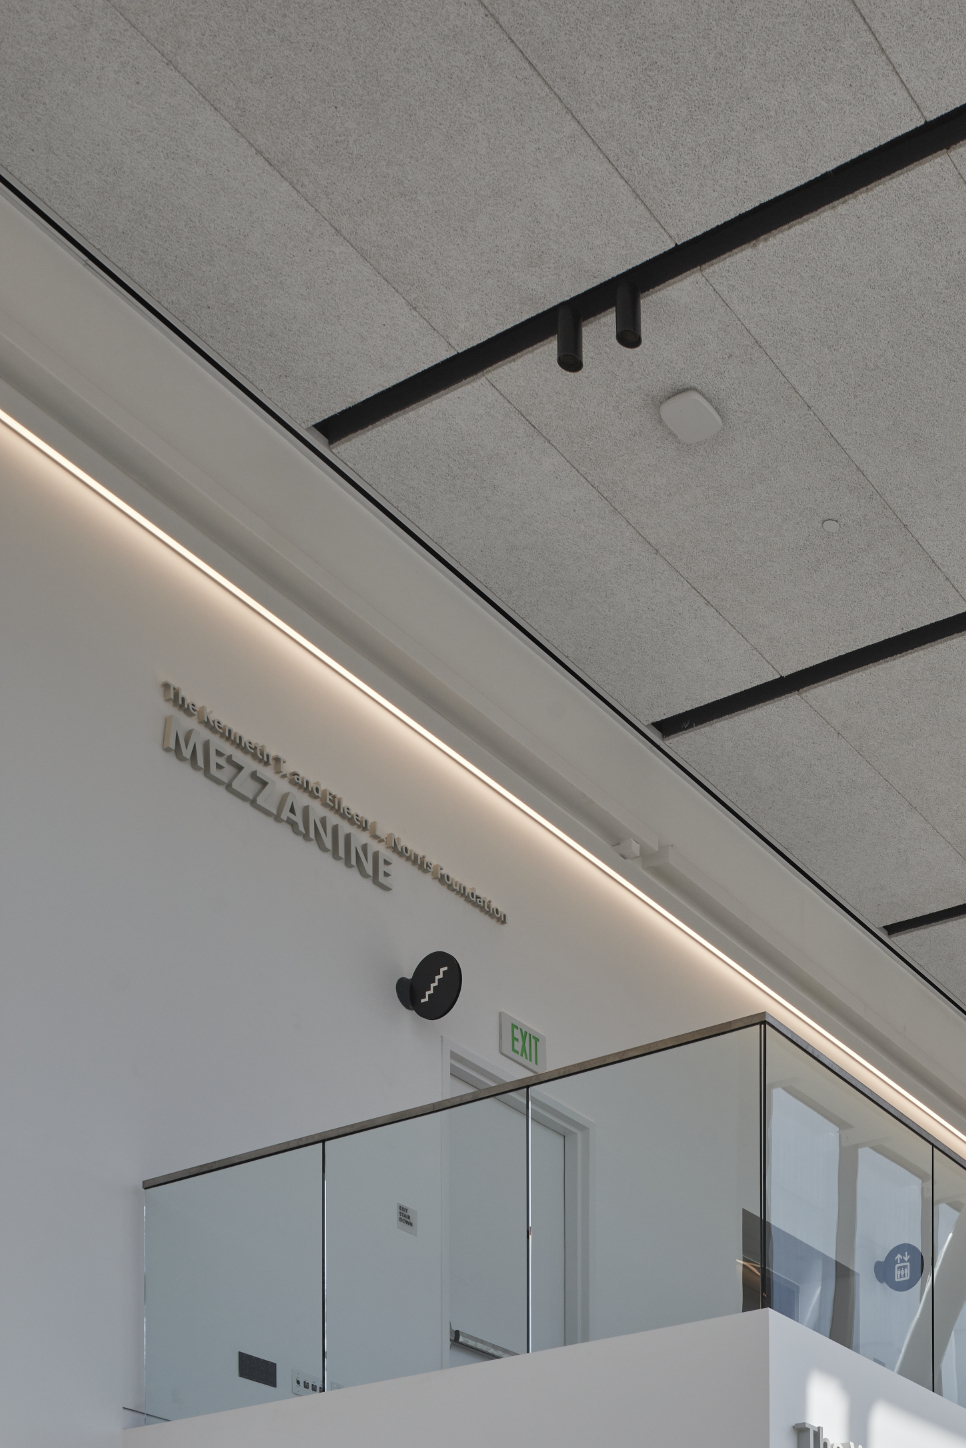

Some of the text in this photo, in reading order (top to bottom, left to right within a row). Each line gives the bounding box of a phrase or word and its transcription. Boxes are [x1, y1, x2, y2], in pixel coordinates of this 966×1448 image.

[161, 680, 198, 715] The
[198, 705, 272, 766] Kenneth
[291, 769, 322, 800] and
[321, 787, 370, 831] Eileen
[370, 820, 386, 843] L.
[386, 833, 433, 873] Norris
[432, 862, 508, 925] Foundation
[163, 714, 394, 892] MEZZANINE
[511, 1022, 540, 1065] EXIT
[399, 1217, 413, 1227] DOWN
